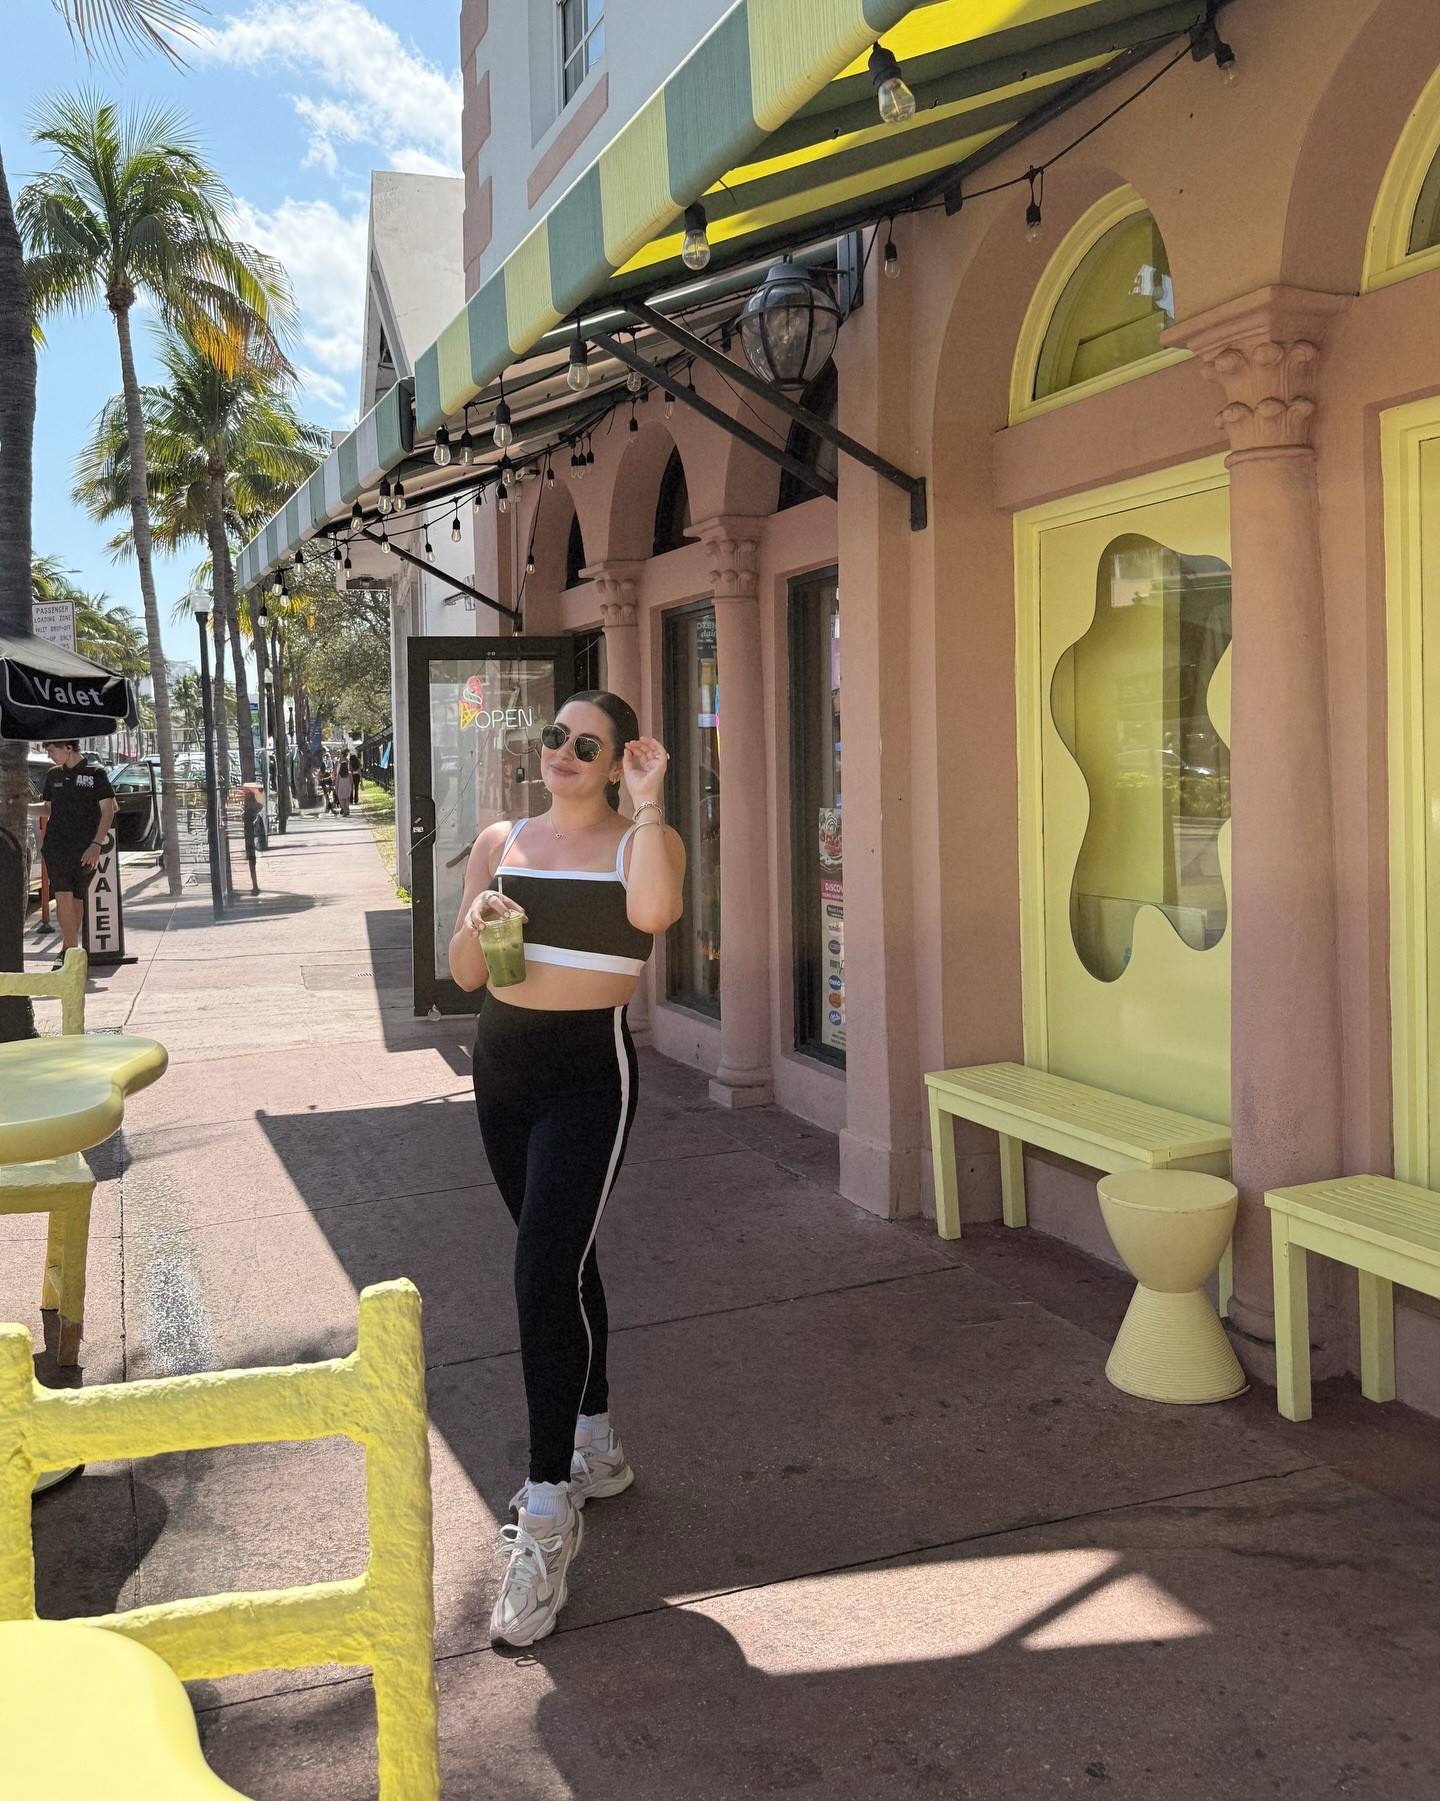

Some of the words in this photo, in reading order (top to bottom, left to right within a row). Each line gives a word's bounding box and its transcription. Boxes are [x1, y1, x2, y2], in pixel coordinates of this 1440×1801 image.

[36, 606, 69, 614] PASSENGER
[33, 676, 105, 706] Valet
[475, 708, 533, 729] OPEN
[94, 856, 112, 950] VALET
